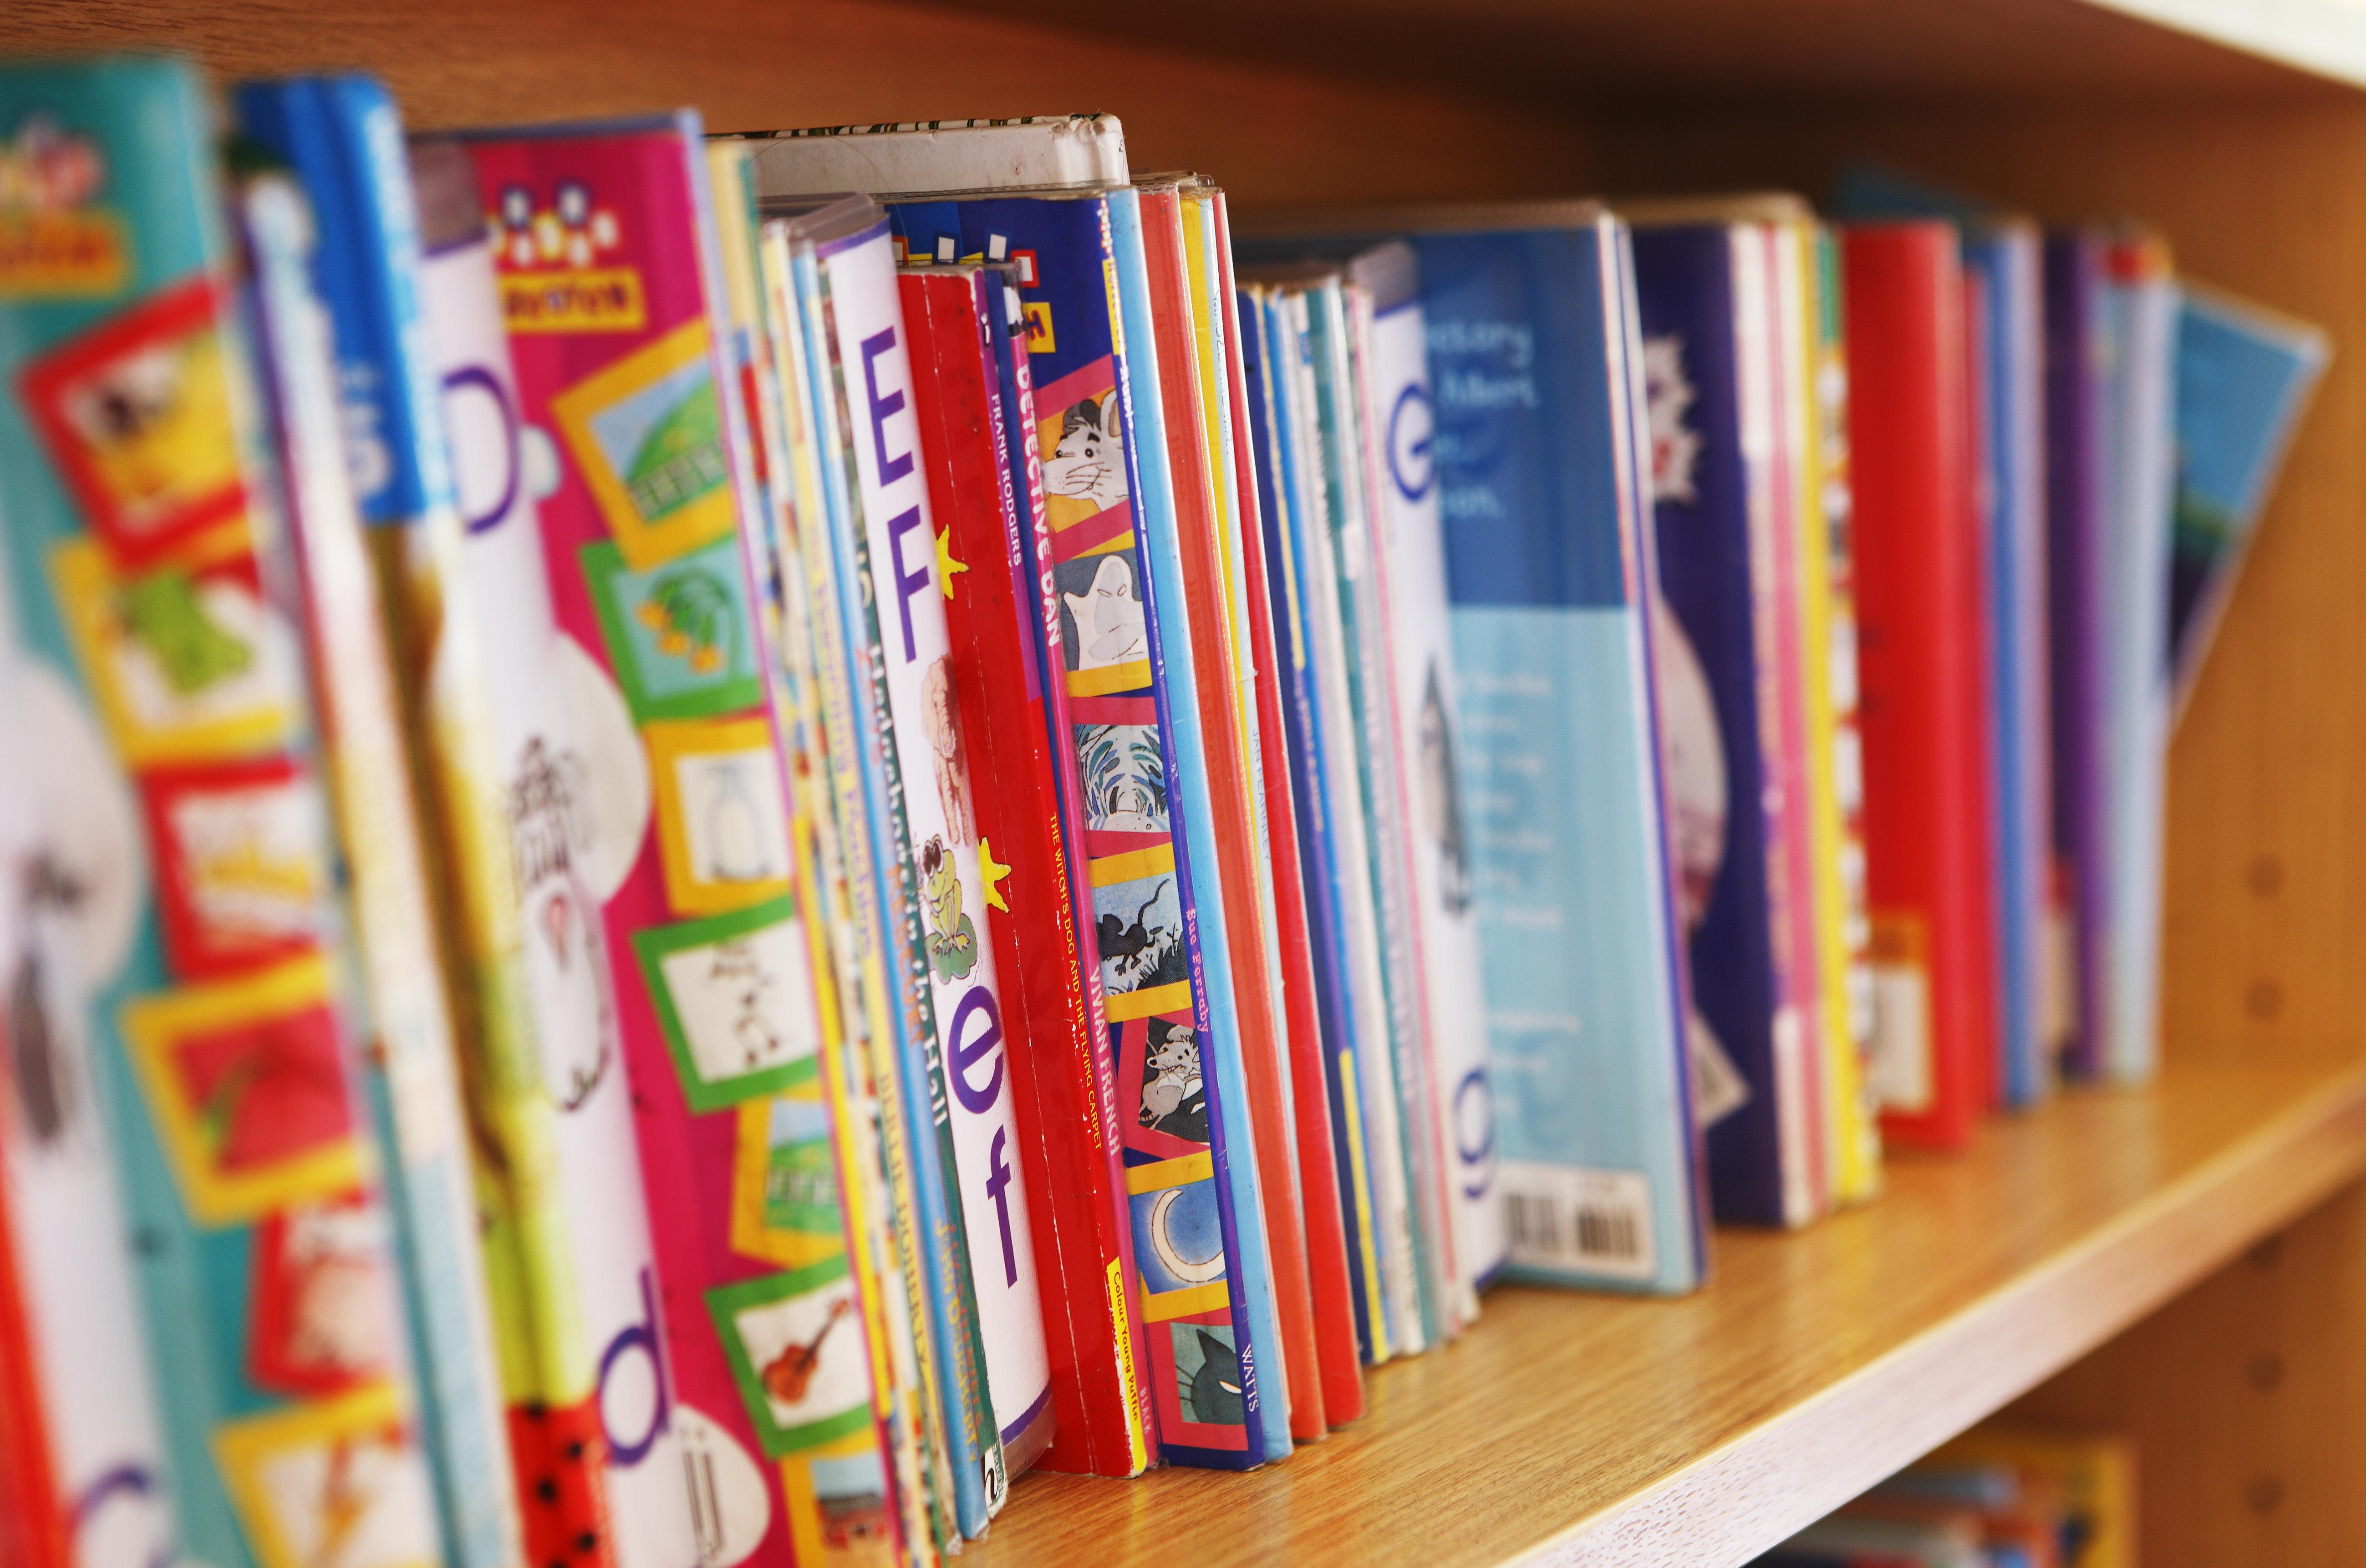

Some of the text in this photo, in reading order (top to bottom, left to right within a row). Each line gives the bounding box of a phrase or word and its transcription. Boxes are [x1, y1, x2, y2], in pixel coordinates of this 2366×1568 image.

[861, 326, 914, 488] E
[991, 394, 1022, 566] FRANK RODGERS
[887, 504, 930, 664] F
[1017, 364, 1050, 560] DETECTIVE
[1040, 571, 1061, 647] DAN
[1252, 728, 1270, 860] JAN FEARNLEY
[911, 959, 930, 1022] the
[923, 1033, 948, 1127] Hall
[947, 985, 1002, 1114] e
[1050, 813, 1103, 1150] THE WITCH'S DOG AND THE FLYING CARPET
[1186, 908, 1209, 1033] Sue Ferraby
[1089, 966, 1120, 1156] VIVIAN FRENCH
[986, 1125, 1018, 1289] f
[596, 1263, 672, 1471] d
[1114, 1271, 1125, 1323] Colour
[1121, 1326, 1131, 1374] Young
[1242, 1343, 1259, 1413] WATTS
